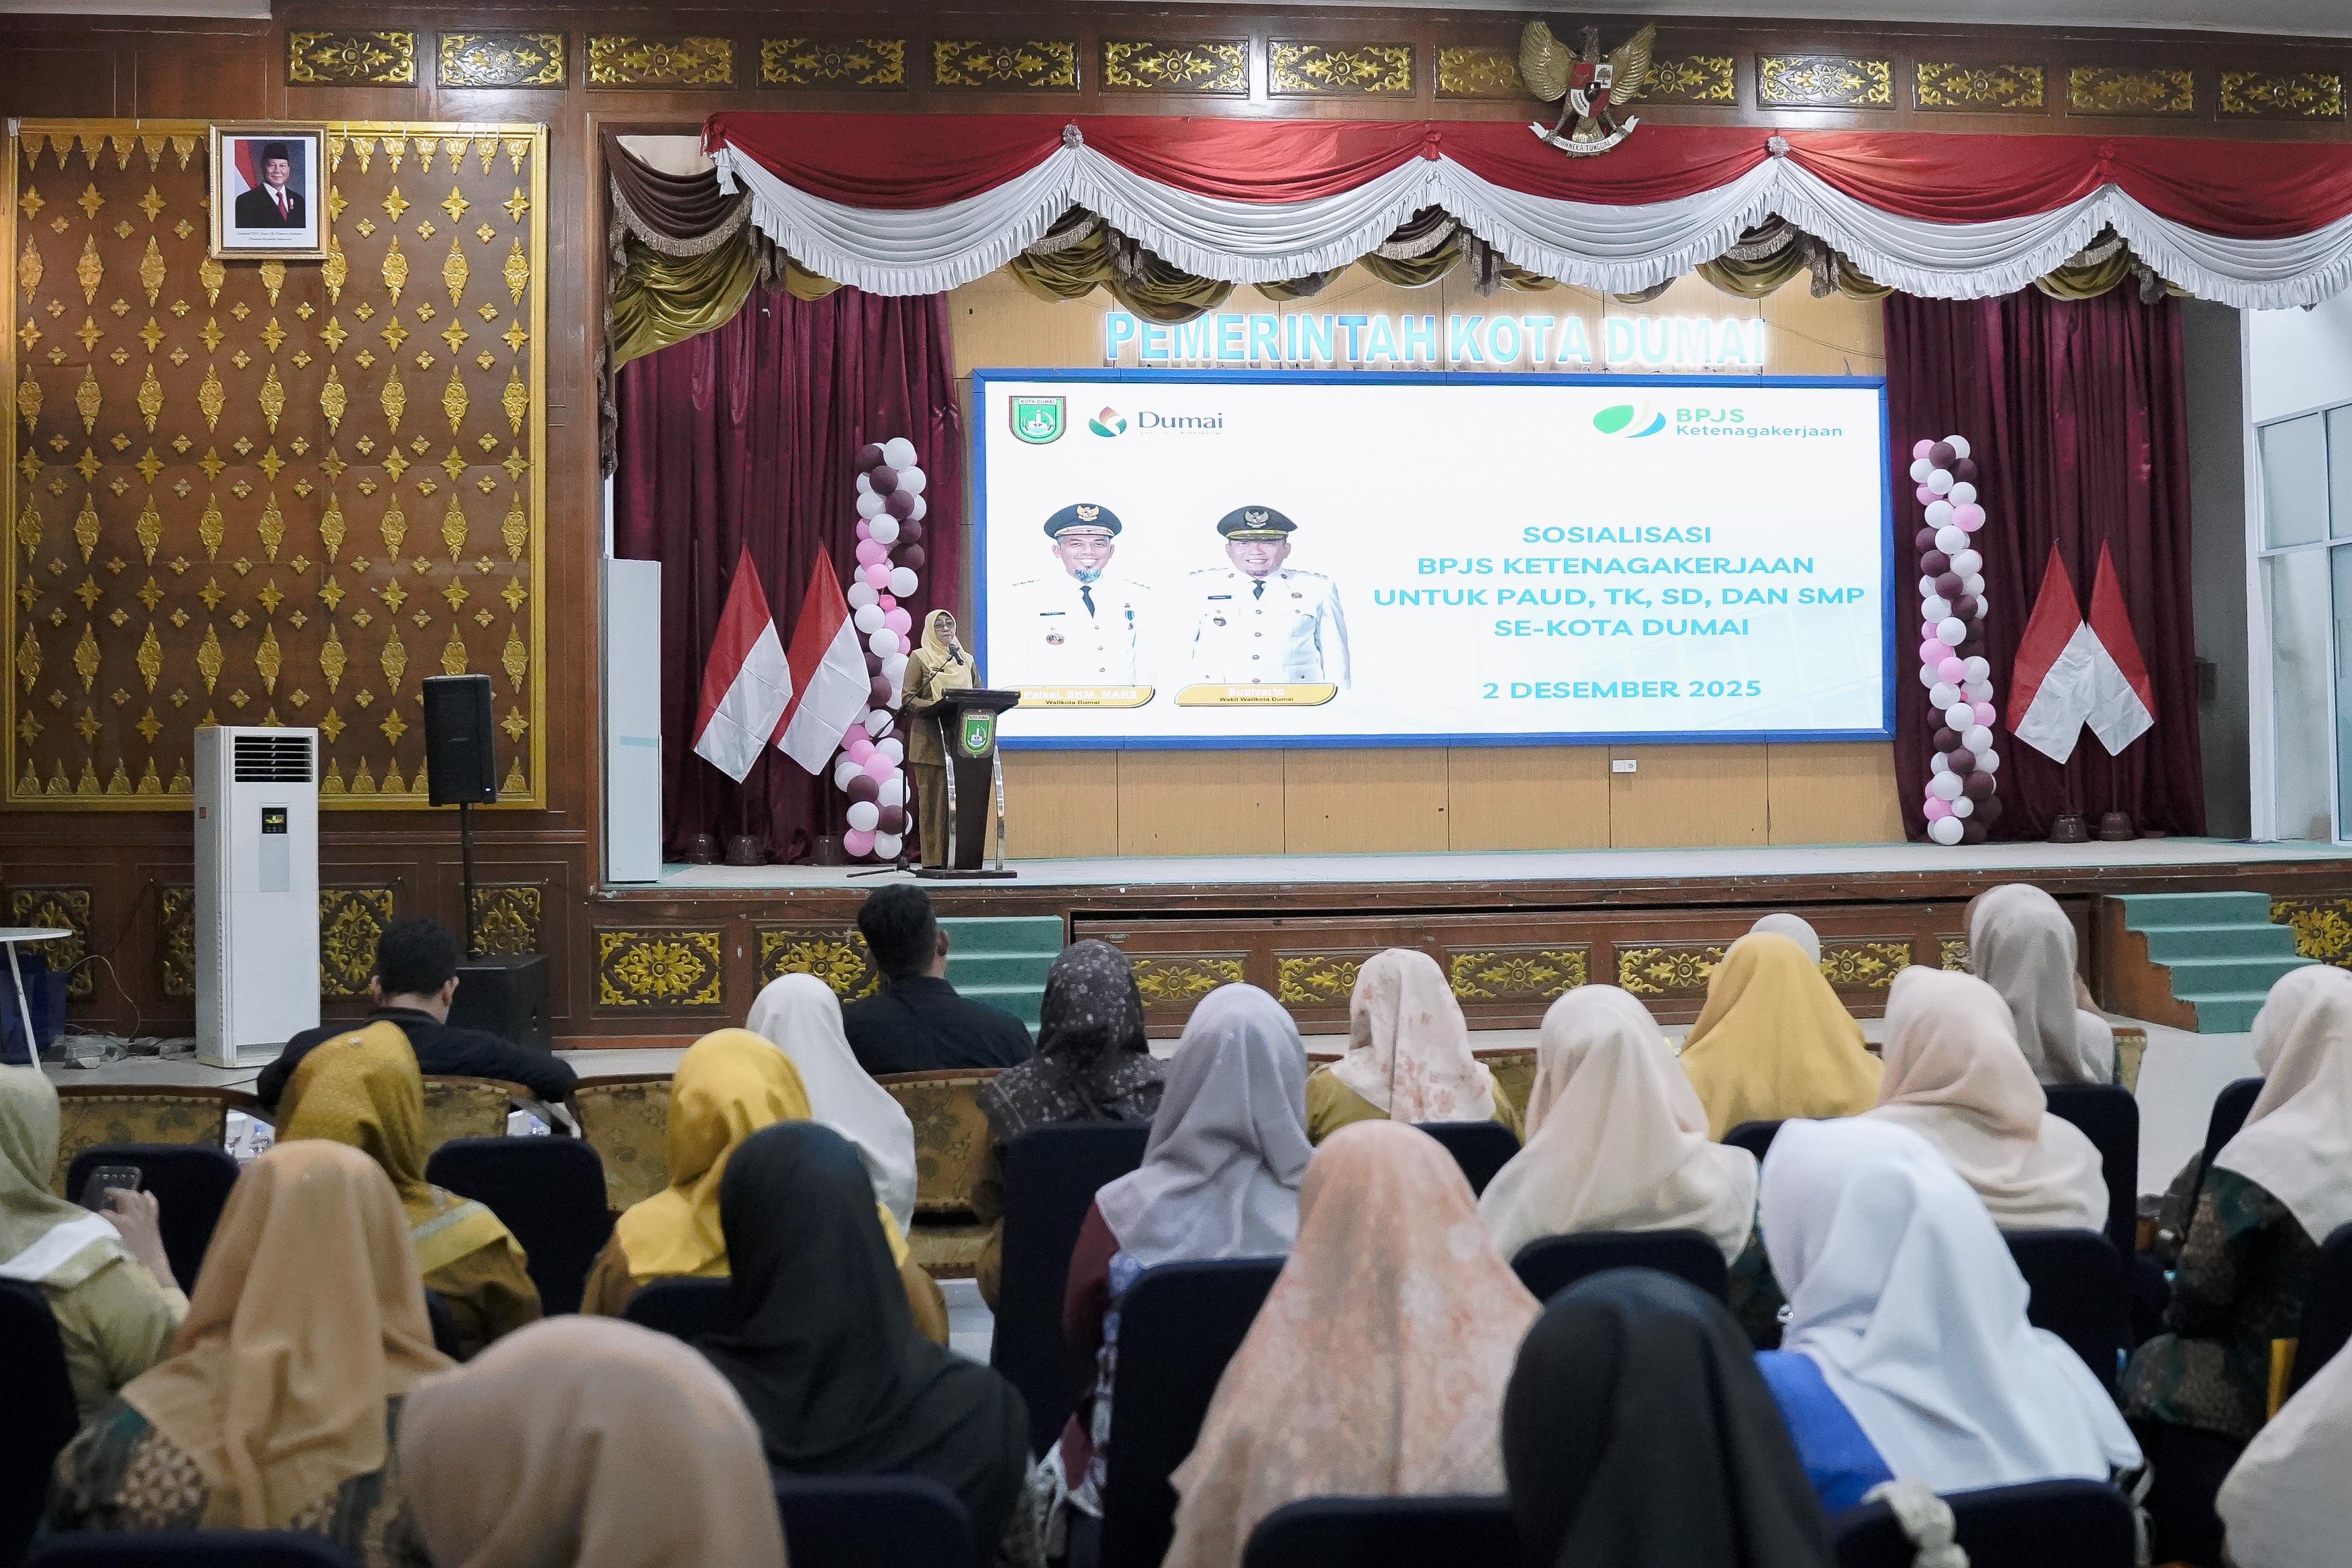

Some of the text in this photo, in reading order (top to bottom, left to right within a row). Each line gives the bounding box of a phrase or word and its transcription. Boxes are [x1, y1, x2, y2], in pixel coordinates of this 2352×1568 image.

[1555, 137, 1612, 152] BHINNEKA TUNGGAL
[1106, 311, 1765, 366] PEMERINTAH KOTA DUMAI
[1138, 411, 1224, 428] Dumai
[1676, 408, 1745, 423] BPJS
[1676, 425, 1843, 438] Ketenagakerjaan
[1522, 526, 1711, 543] SOSIALISASI
[1418, 557, 1814, 575] BPJS KETENAGAKERJAAN
[1374, 587, 1865, 609] UNTUK PAUD, TK, SD, DAN SMP
[1494, 618, 1749, 636] SE-KOTA DUMAI
[1482, 679, 1762, 699] 2 DESEMBER 2025
